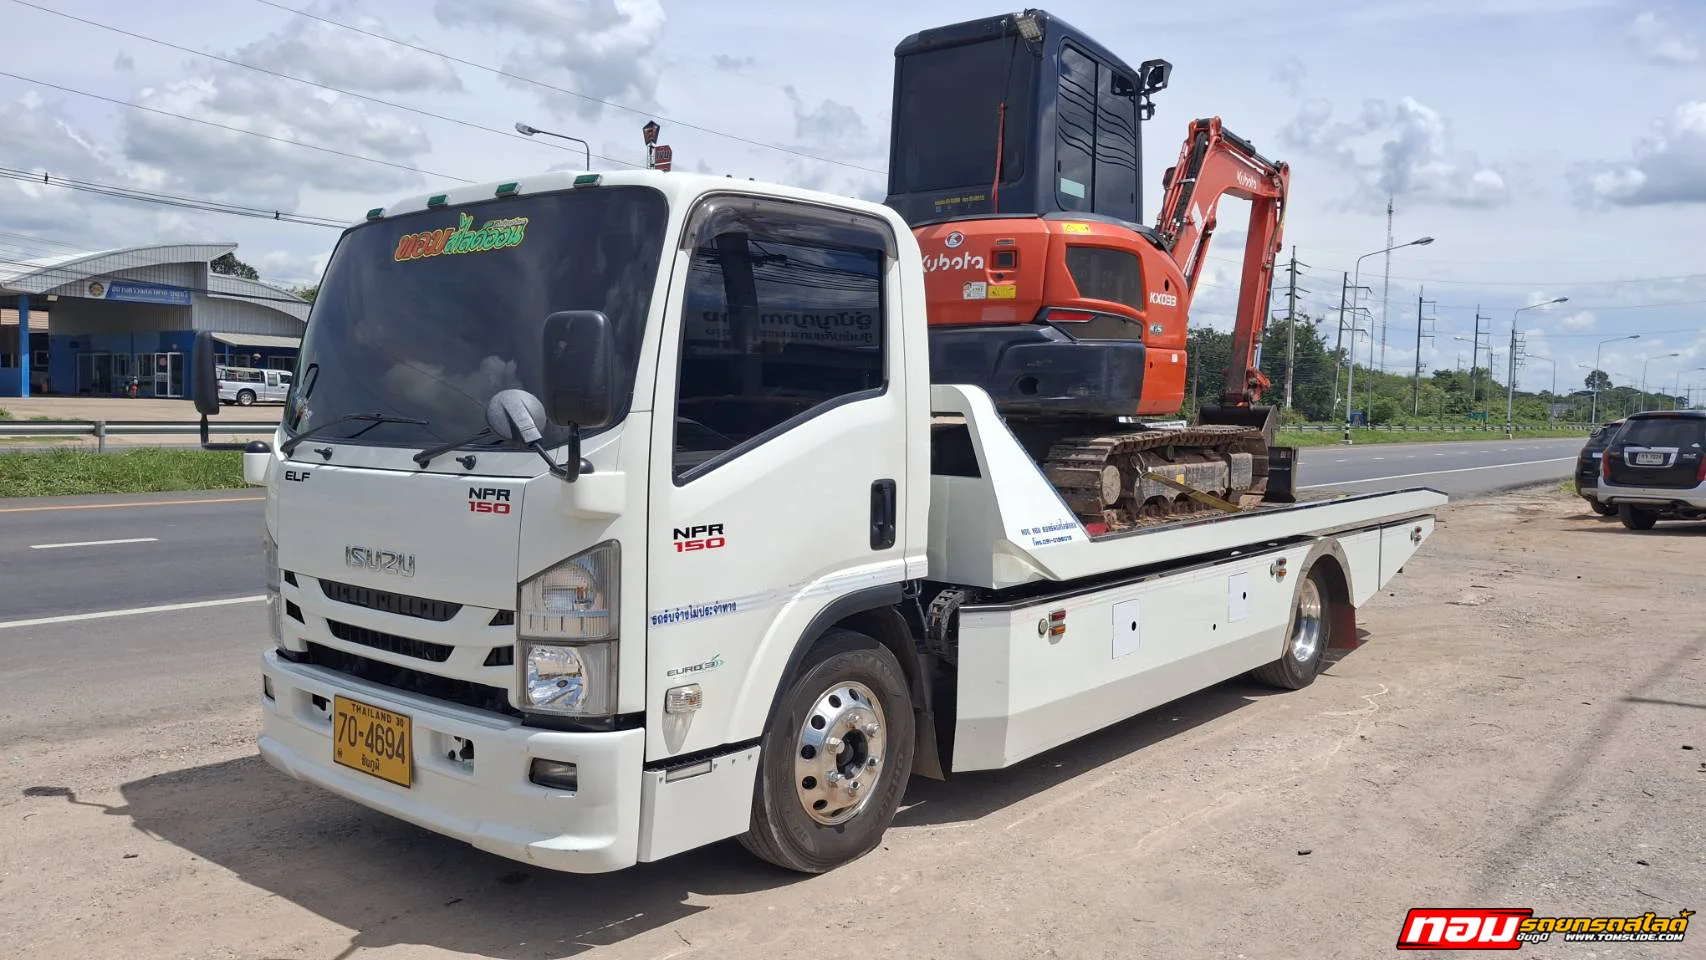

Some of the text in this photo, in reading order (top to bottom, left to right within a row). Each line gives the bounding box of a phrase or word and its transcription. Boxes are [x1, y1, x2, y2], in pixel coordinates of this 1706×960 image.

[922, 252, 984, 272] Kubota
[285, 471, 311, 482] ELF
[468, 487, 511, 501] NPR
[468, 501, 511, 515] 150
[673, 523, 724, 540] NPR
[673, 537, 725, 553] 150
[345, 545, 416, 578] ISUZU
[651, 601, 737, 626] รถรับจ้างไม่ประจำทาง
[352, 704, 391, 723] THAILAND
[338, 712, 406, 764] 70-4694
